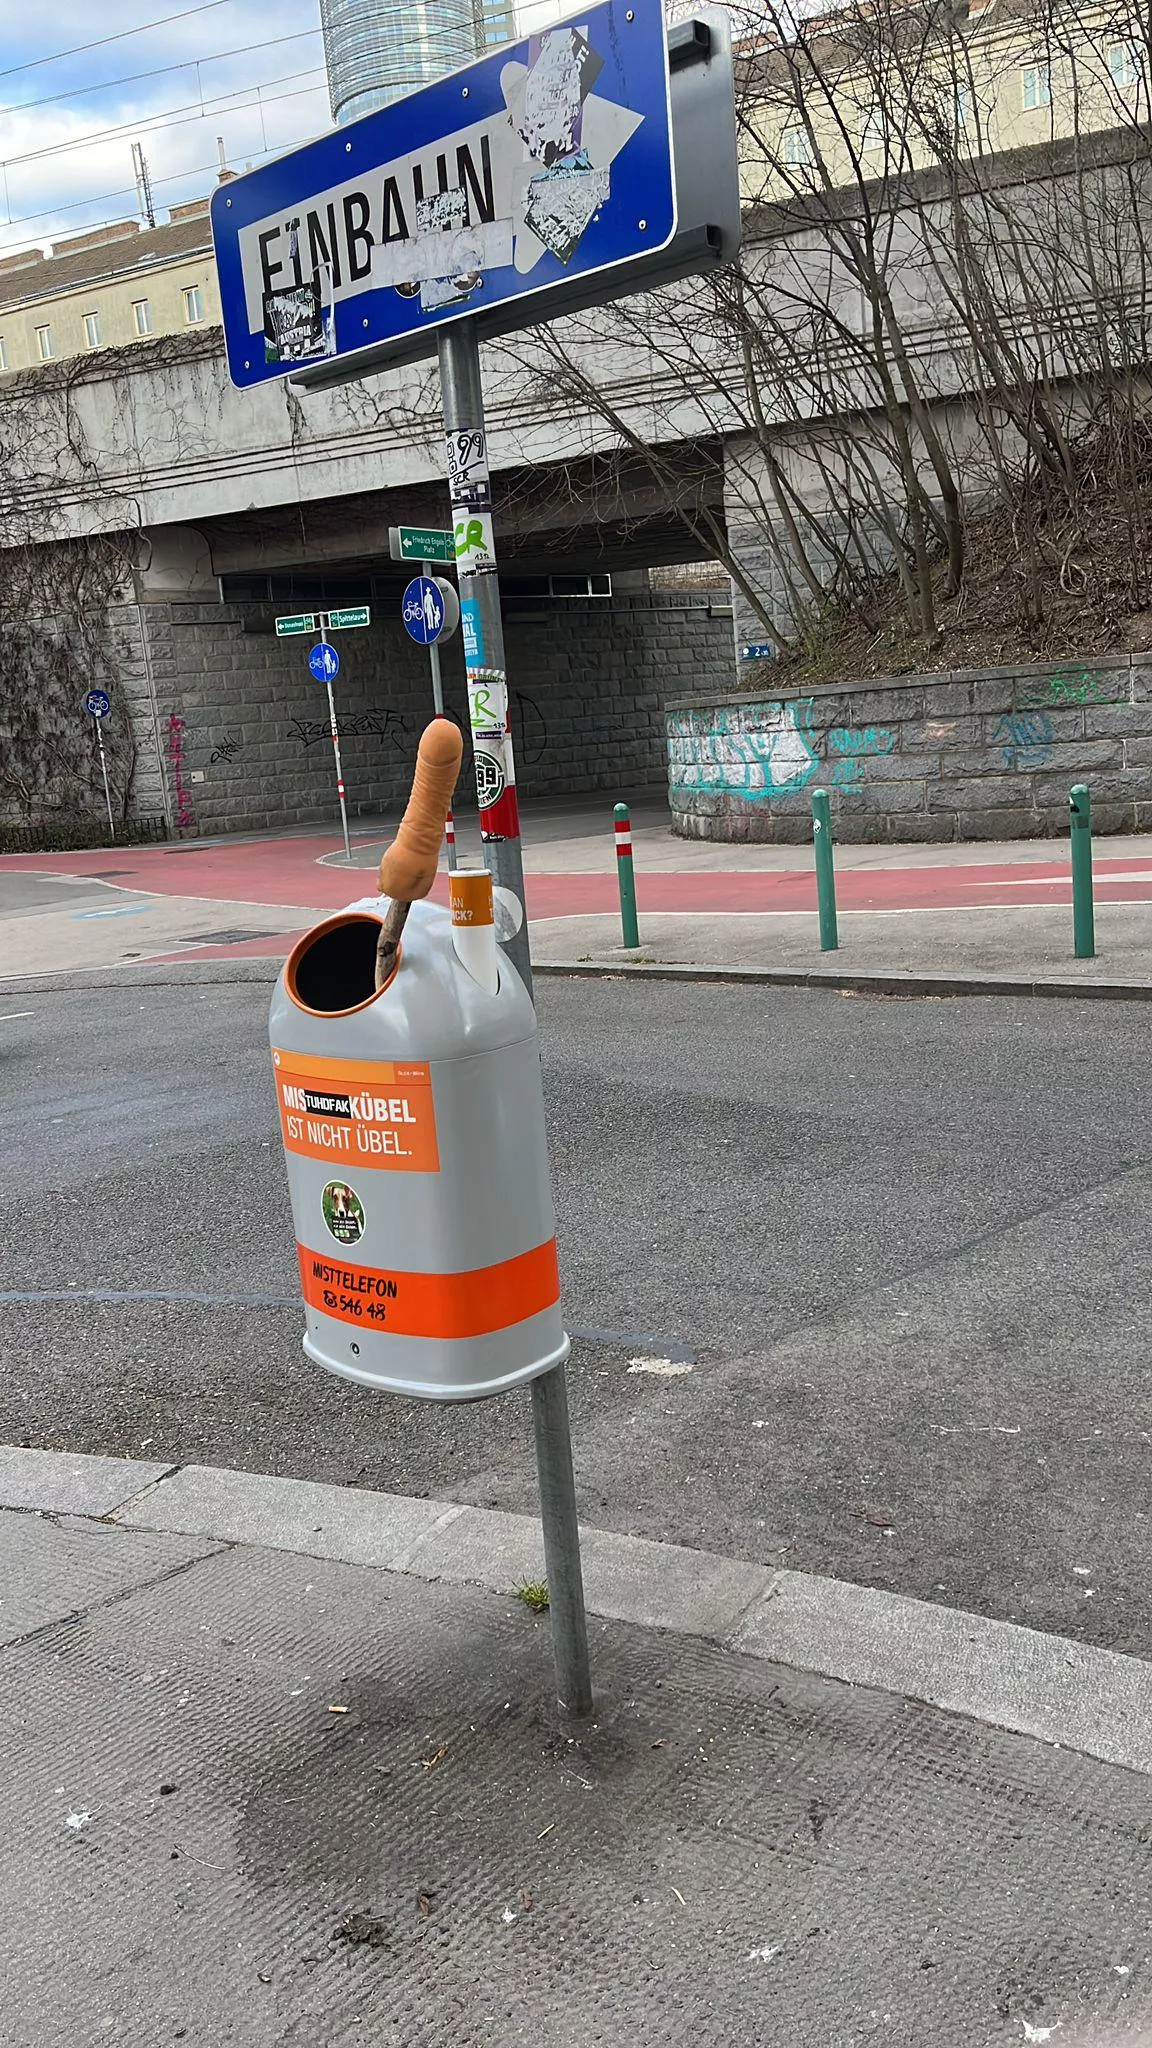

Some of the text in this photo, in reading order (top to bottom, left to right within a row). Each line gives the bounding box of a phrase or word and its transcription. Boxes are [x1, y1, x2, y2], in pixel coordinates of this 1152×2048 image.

[286, 1115, 413, 1156] IST NICHT ÜBEL.
[313, 1260, 398, 1298] MISTTELEFON
[339, 1295, 386, 1321] 546 48
